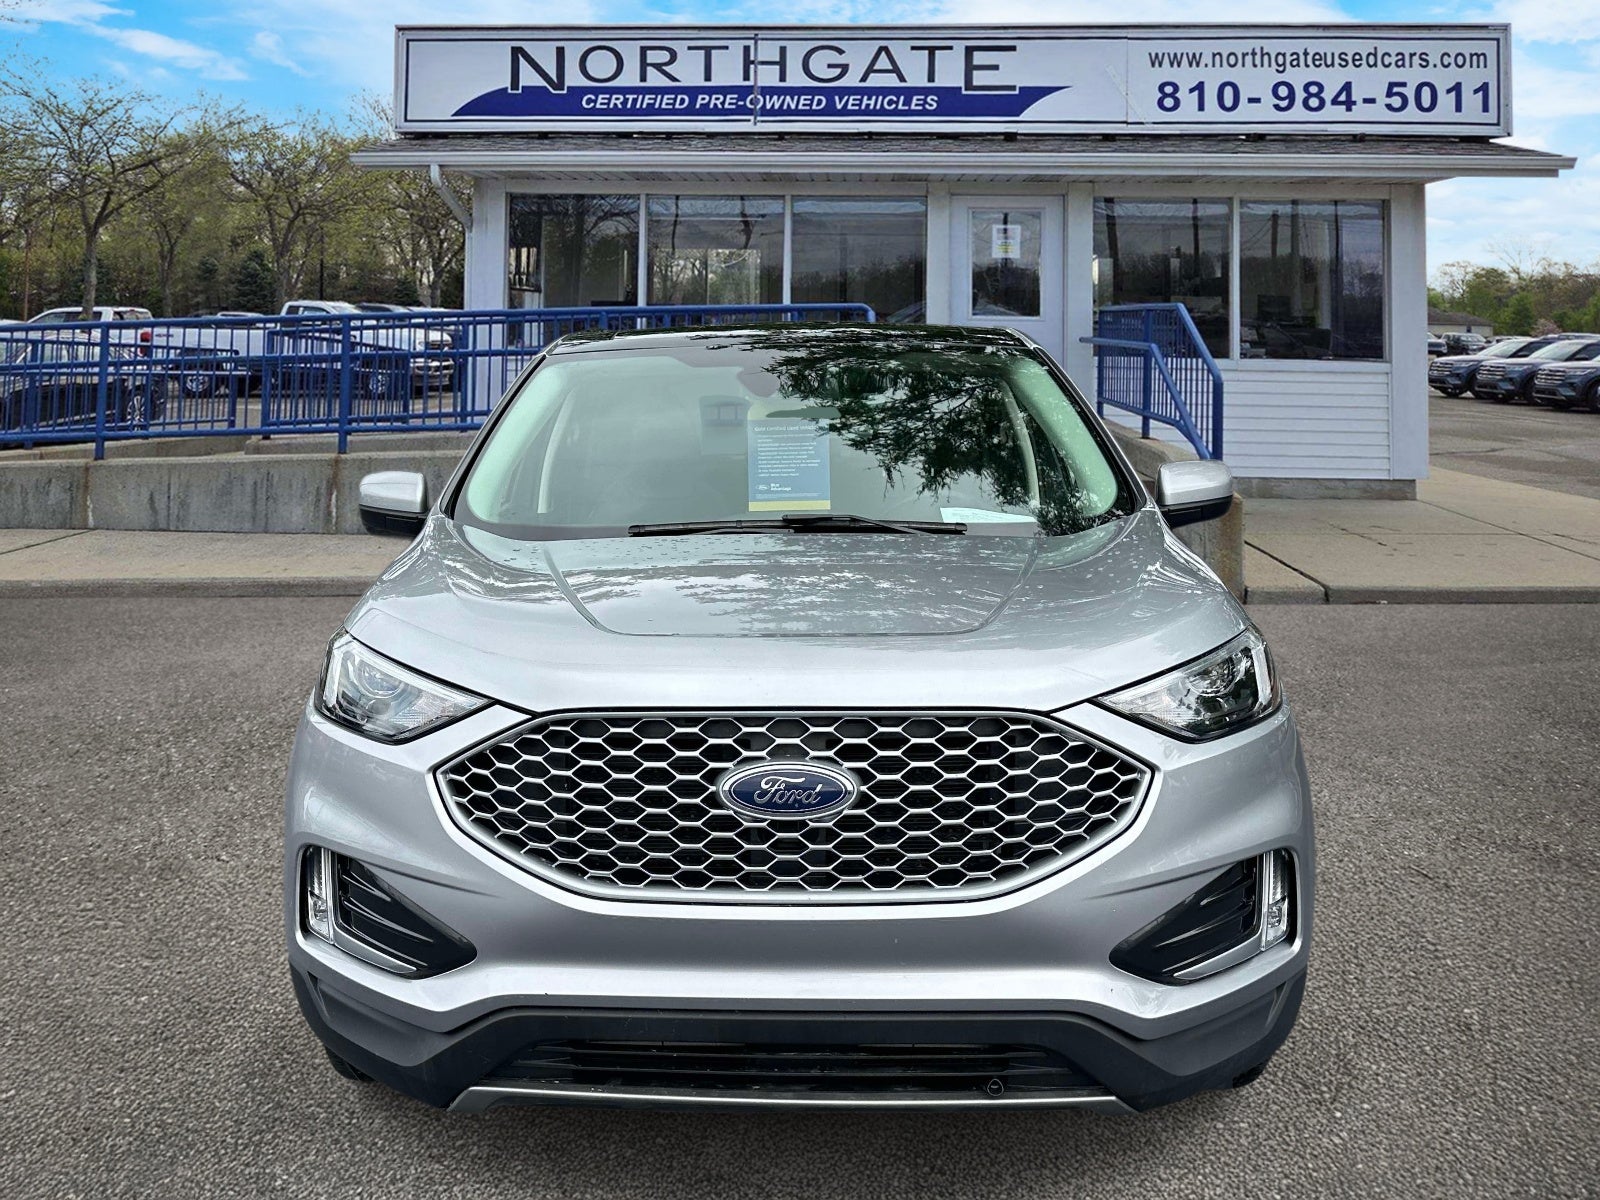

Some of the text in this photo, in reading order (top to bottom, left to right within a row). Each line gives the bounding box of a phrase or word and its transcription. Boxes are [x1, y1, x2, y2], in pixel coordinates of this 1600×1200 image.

[510, 45, 1017, 91] NORTHGATE
[1149, 47, 1488, 73] www.northgateusedcars.com
[581, 93, 938, 111] CERTIFIED PRE-OWNED VEHICLES
[1156, 80, 1491, 113] 810-984-5011
[753, 776, 823, 804] Ford
